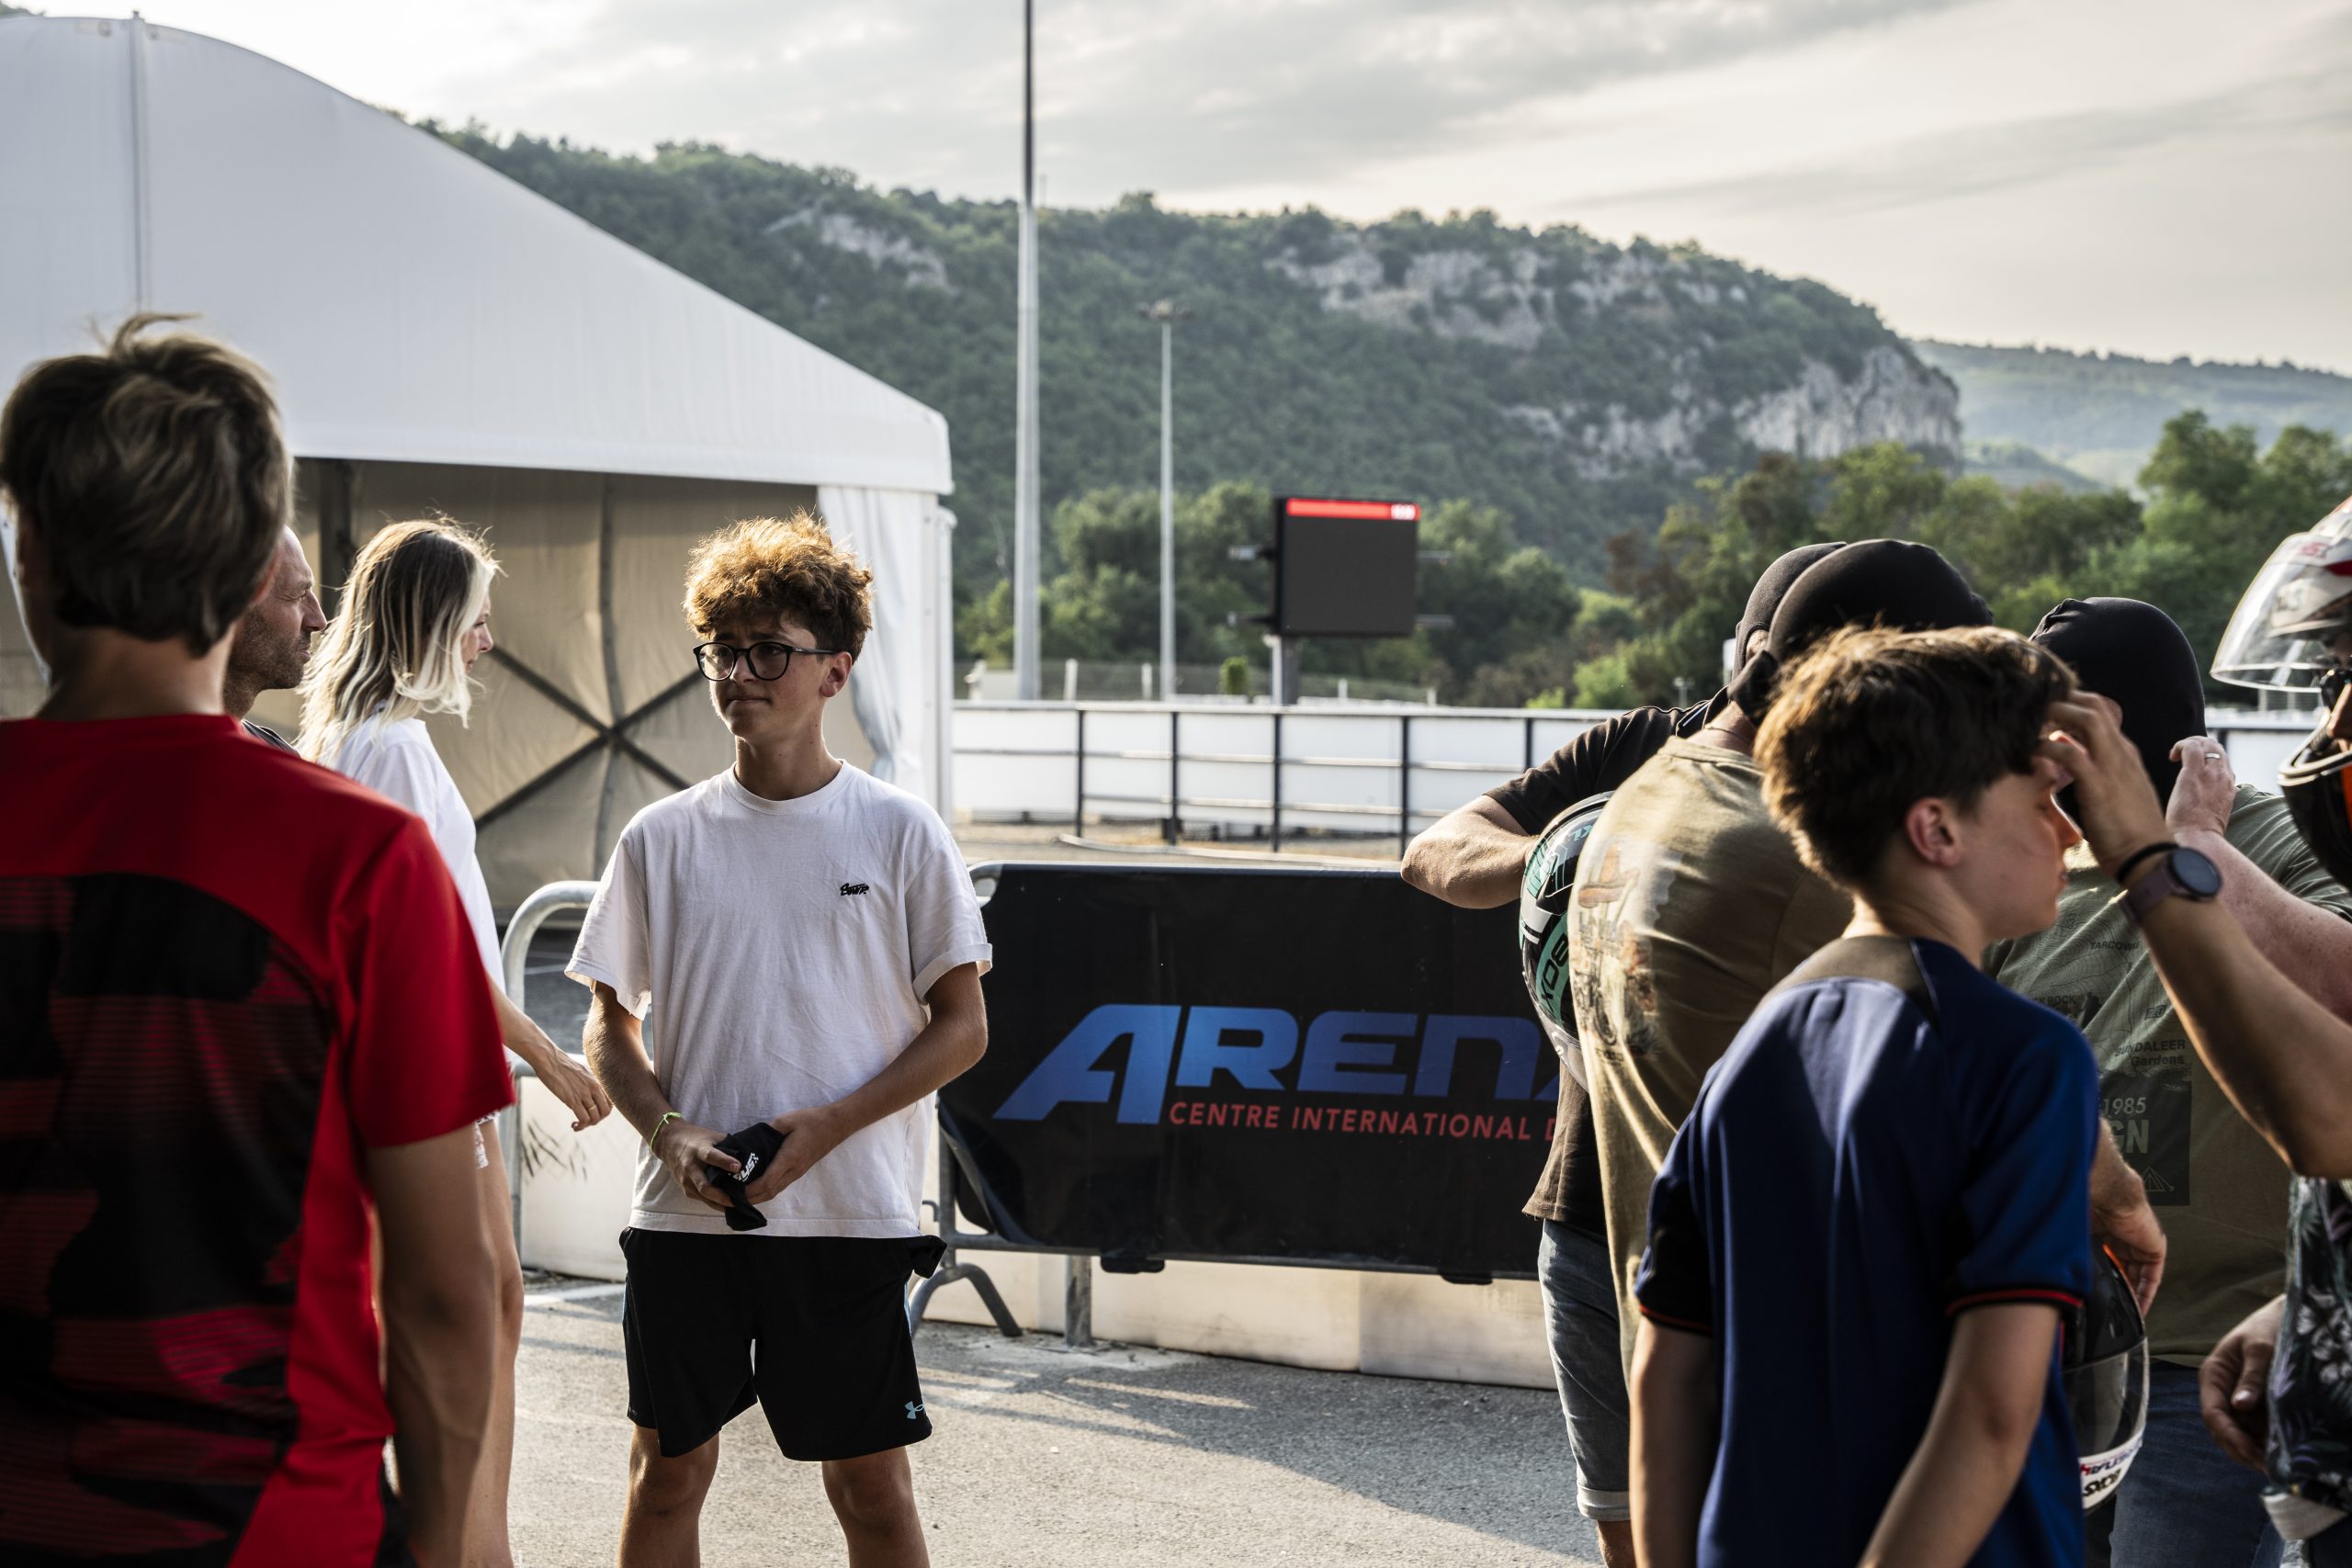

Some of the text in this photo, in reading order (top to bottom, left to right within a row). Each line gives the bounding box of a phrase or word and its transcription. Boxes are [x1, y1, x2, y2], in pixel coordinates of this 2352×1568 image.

[993, 1004, 1560, 1124] AREN
[2131, 1055, 2185, 1066] Gardens
[2102, 1096, 2147, 1115] 1985
[1169, 1101, 1281, 1129] CENTRE
[1291, 1106, 1531, 1141] INTERNATIONAL
